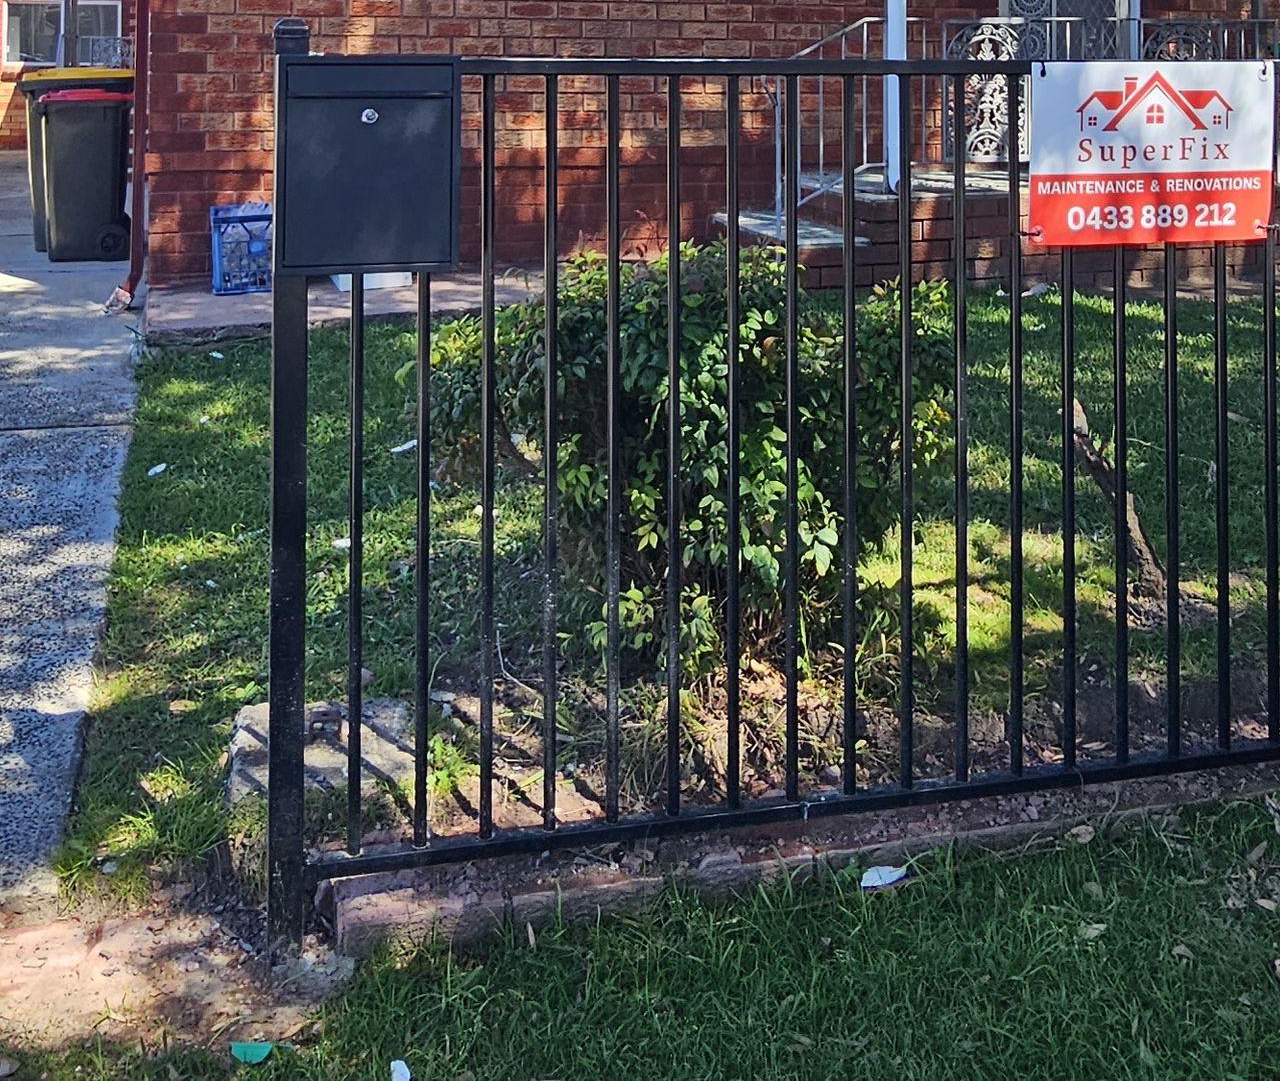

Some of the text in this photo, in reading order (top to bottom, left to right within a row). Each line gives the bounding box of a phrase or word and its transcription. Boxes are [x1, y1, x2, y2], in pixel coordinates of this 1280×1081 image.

[1077, 136, 1230, 169] SuperFix
[1037, 177, 1262, 195] MAINTENANCE & RENOVATIONS
[1067, 201, 1237, 231] 0433 889 212
